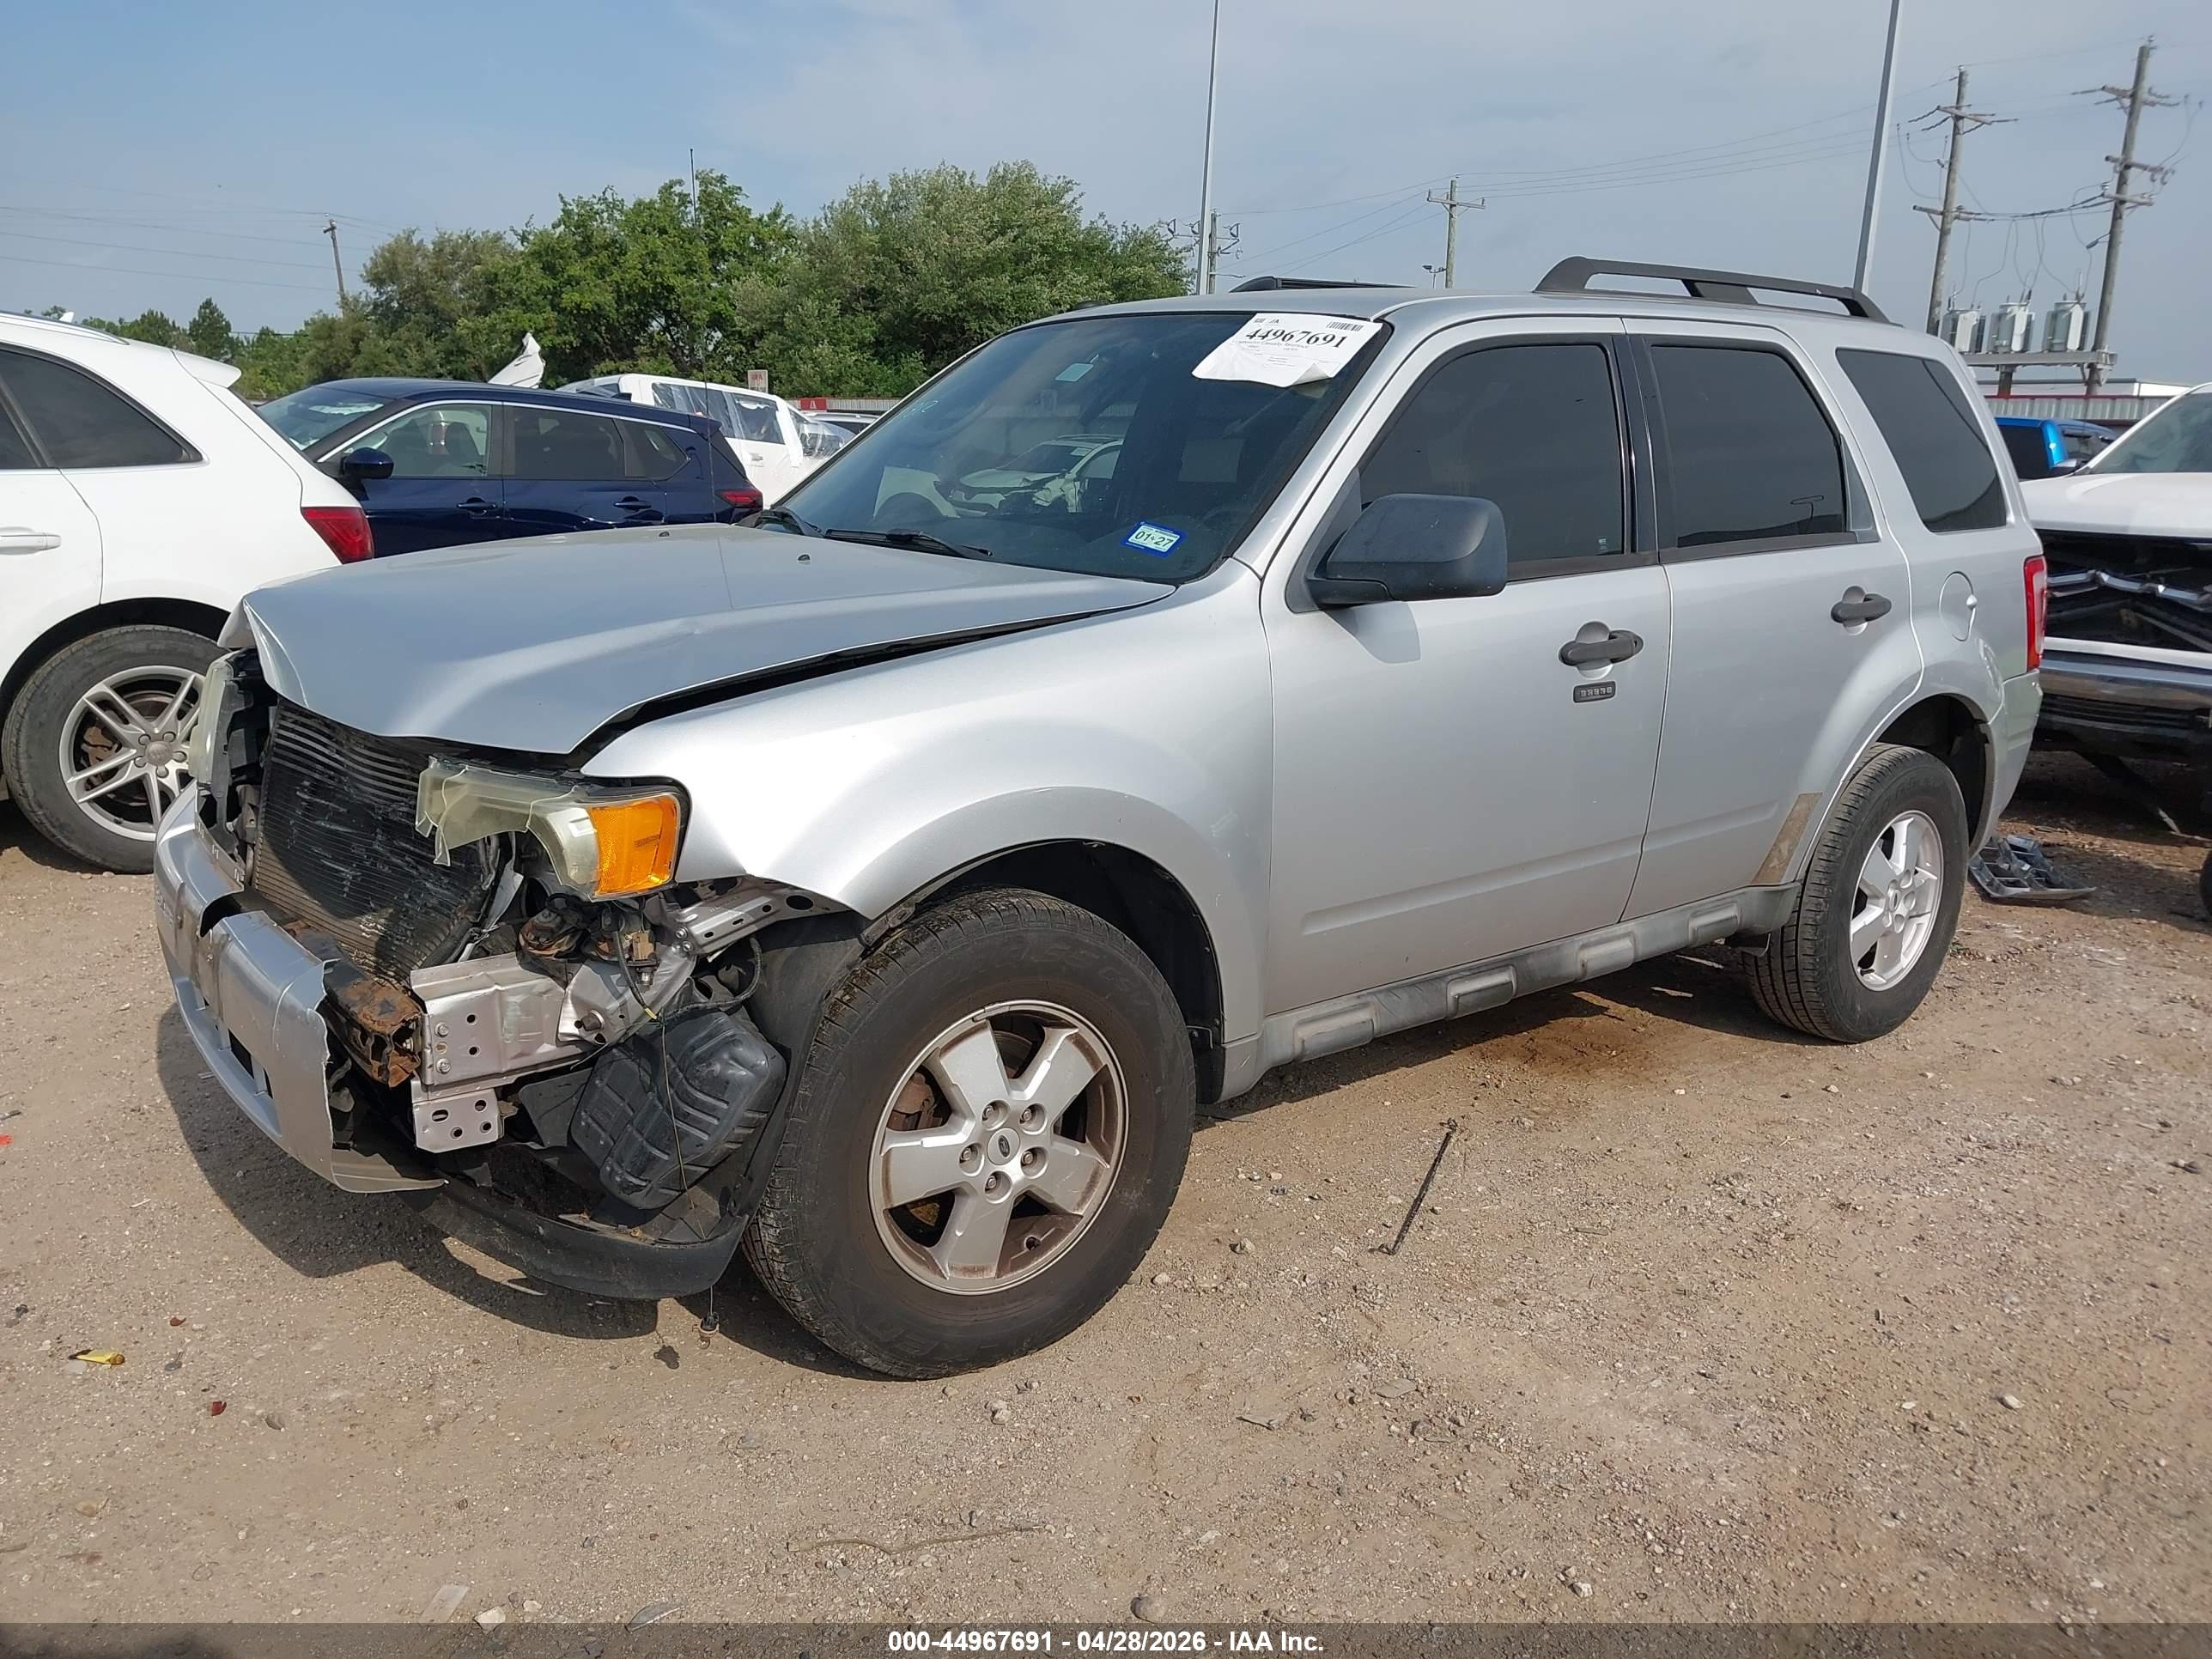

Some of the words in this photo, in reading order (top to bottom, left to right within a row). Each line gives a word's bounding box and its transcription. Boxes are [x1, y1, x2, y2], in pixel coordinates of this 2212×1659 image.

[1245, 328, 1348, 349] 44967691
[1134, 531, 1152, 542] 01
[1153, 536, 1174, 547] 27
